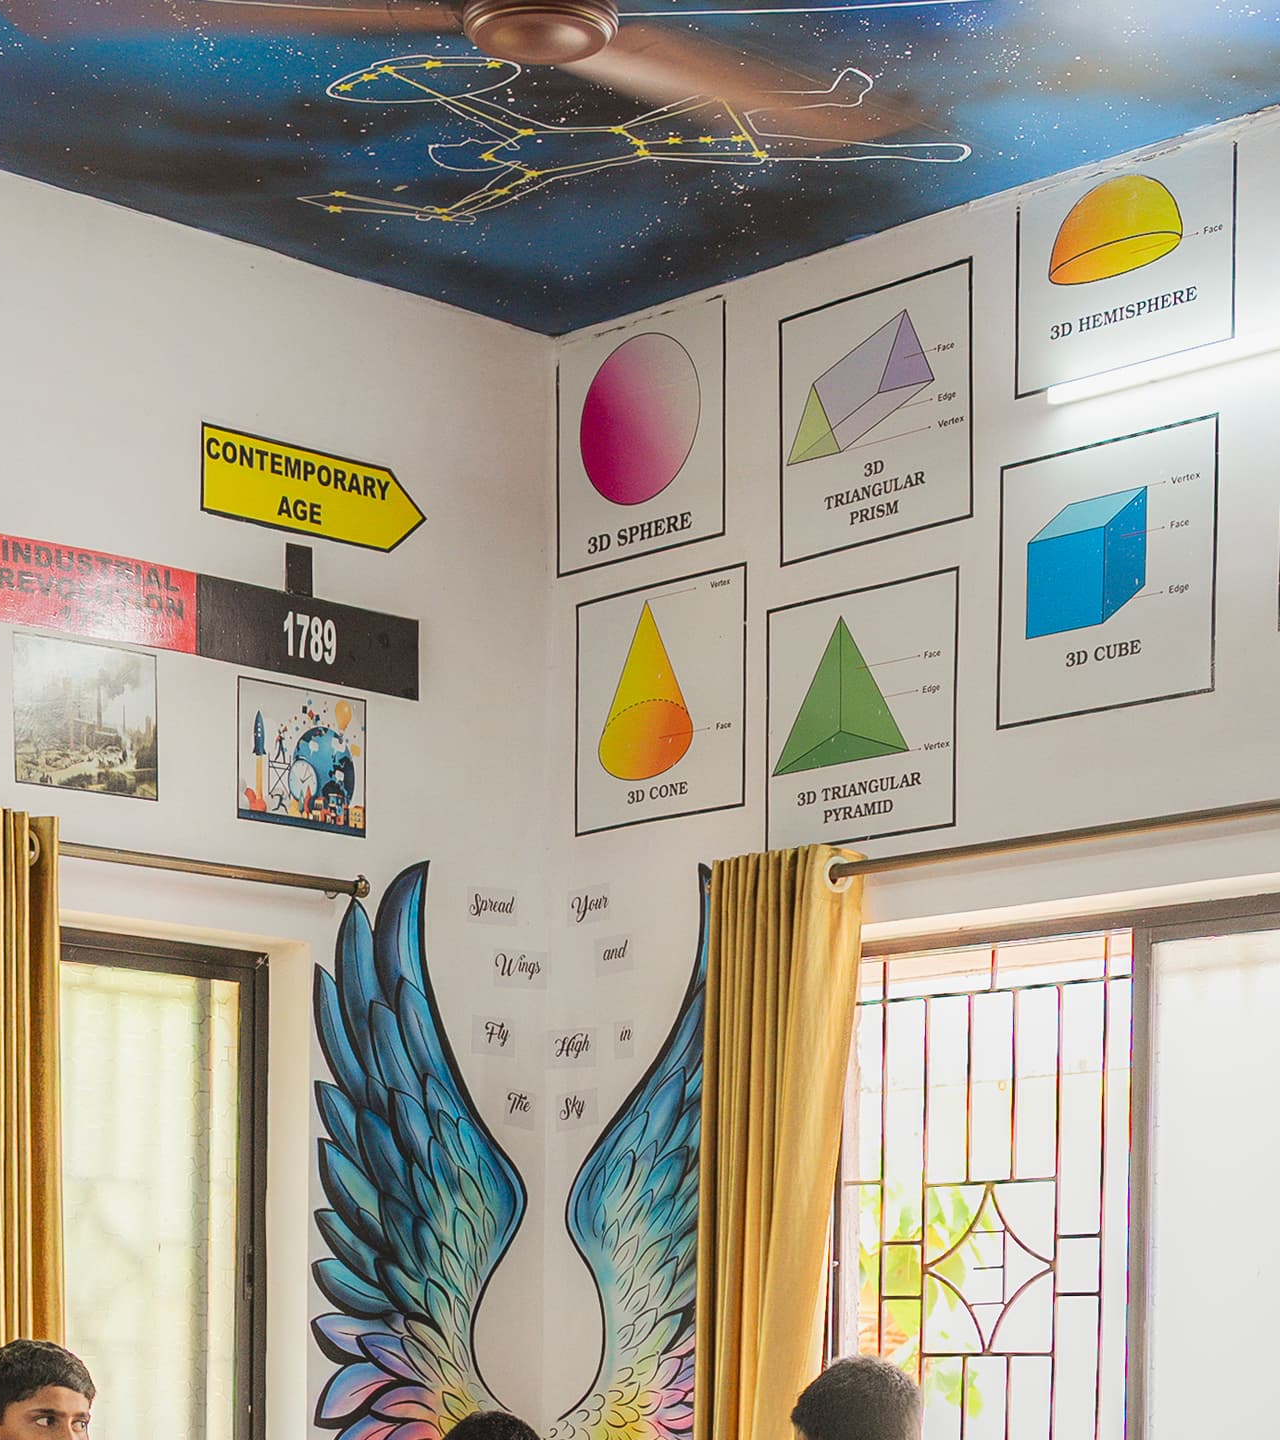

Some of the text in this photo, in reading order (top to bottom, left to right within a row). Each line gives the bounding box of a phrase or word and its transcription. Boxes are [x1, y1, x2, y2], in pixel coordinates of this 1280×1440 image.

[1202, 222, 1224, 236] Face
[1049, 286, 1197, 341] 3D HEMISPHERE
[937, 340, 956, 353] Face
[937, 389, 957, 404] Edge
[937, 414, 965, 429] Vertex
[206, 437, 391, 501] CONTEMPORARY
[863, 459, 885, 479] 3D
[1170, 471, 1201, 486] Vertex
[823, 469, 926, 511] TRIANGULAR
[277, 496, 322, 525] AGE
[848, 500, 900, 527] PRISM
[587, 511, 693, 555] 3D SPHERE
[1169, 518, 1191, 530] Face
[1, 539, 180, 593] INDUSTRIAL
[709, 577, 731, 589] Vertex
[1167, 583, 1191, 597] Edge
[283, 611, 337, 665] 1789
[923, 648, 942, 660] Face
[1065, 639, 1142, 669] 3D CUBE
[921, 682, 942, 696] Edge
[715, 719, 732, 731] Face
[923, 738, 950, 752] Vertex
[627, 781, 689, 805] 3D CONE
[796, 770, 923, 807] 3D TRIANGULAR
[822, 799, 894, 824] PYRAMID
[469, 893, 515, 918] Spread
[571, 894, 609, 923] Your
[602, 939, 628, 961] and
[494, 953, 542, 980] Wings
[485, 1021, 511, 1047] Fly
[619, 1025, 633, 1042] in
[554, 1033, 591, 1059] High
[507, 1091, 531, 1114] The
[560, 1096, 585, 1121] Sky
